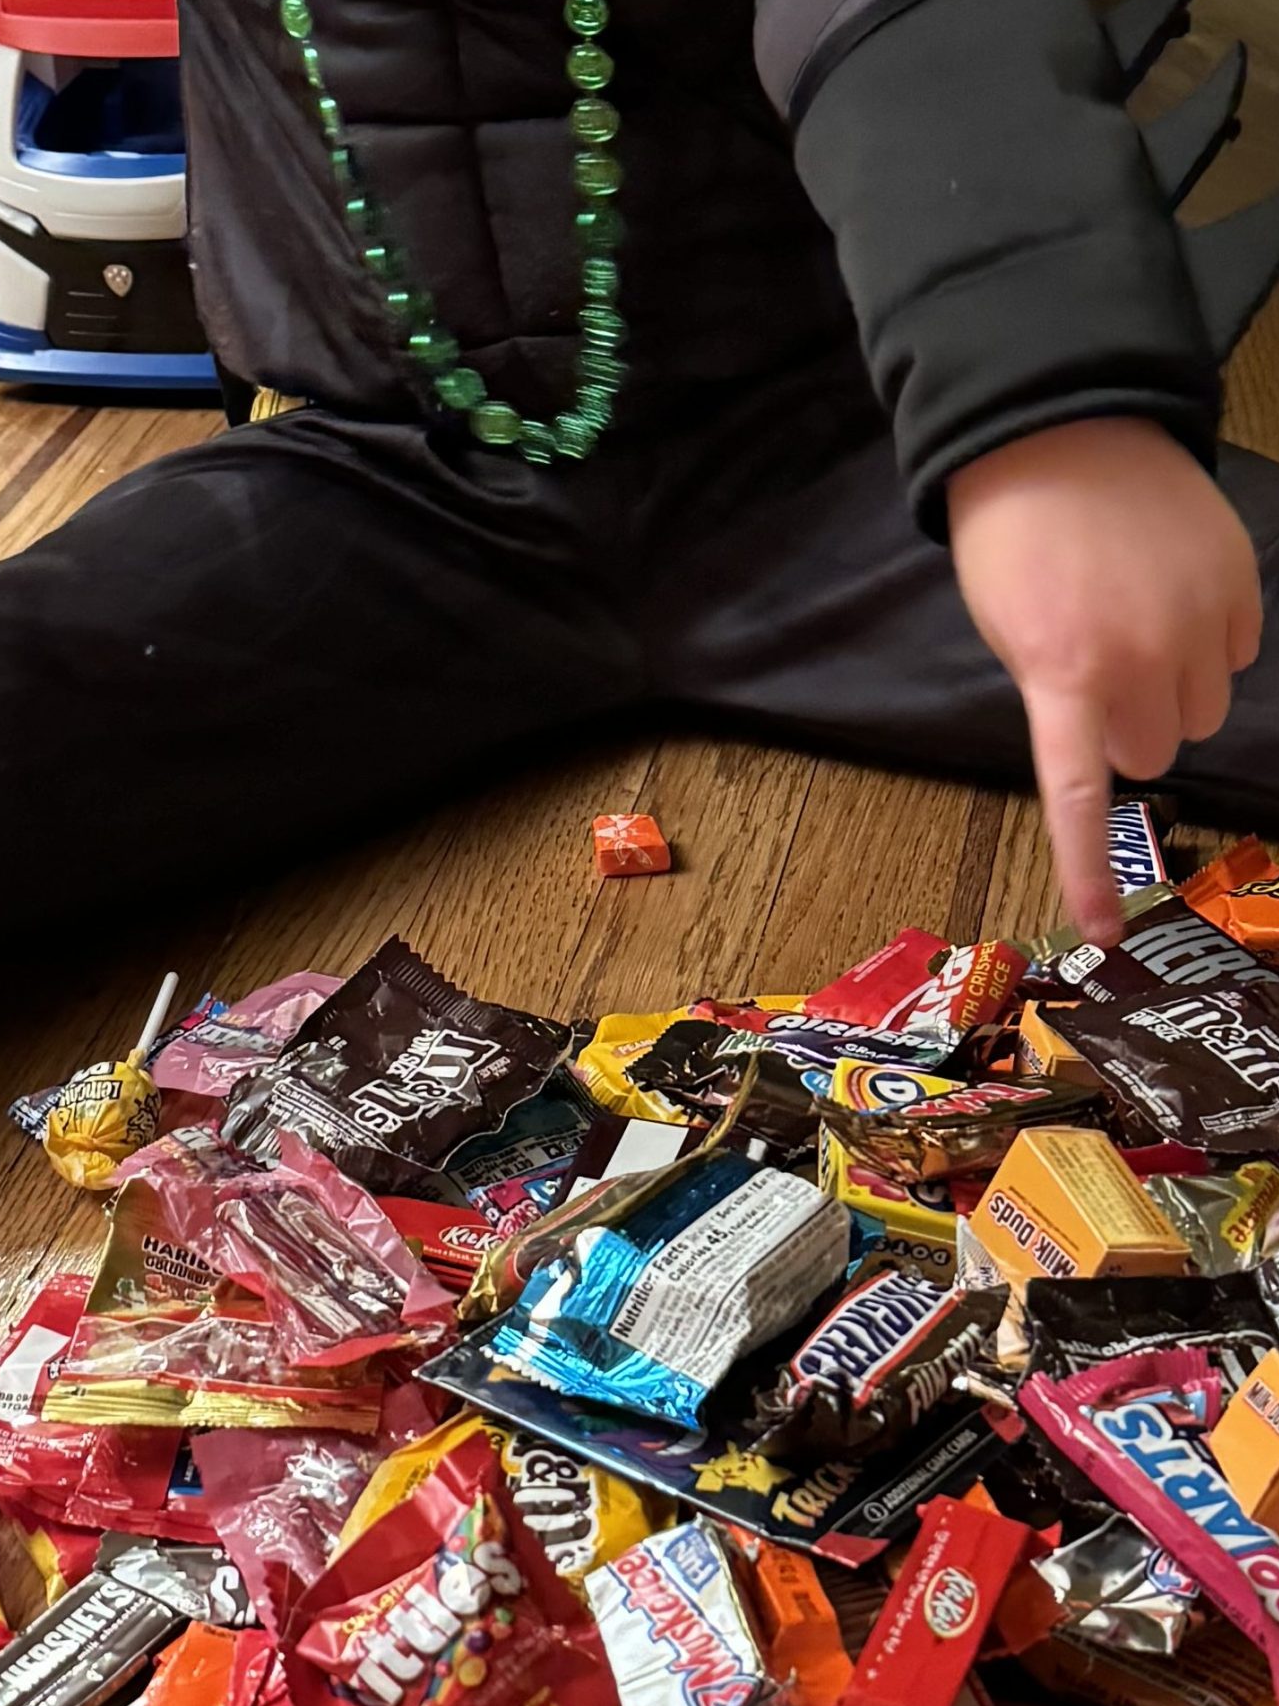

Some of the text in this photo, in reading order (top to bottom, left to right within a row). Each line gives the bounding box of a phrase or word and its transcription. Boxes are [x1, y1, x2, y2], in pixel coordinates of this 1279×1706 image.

[1074, 945, 1102, 971] 210
[987, 959, 1010, 1002] RICE
[987, 1192, 1037, 1249] Duds
[655, 1241, 689, 1276] Facts
[1245, 1382, 1276, 1418] Milk
[664, 1552, 713, 1589] FUN
[0, 1583, 137, 1694] HERSHEY'S
